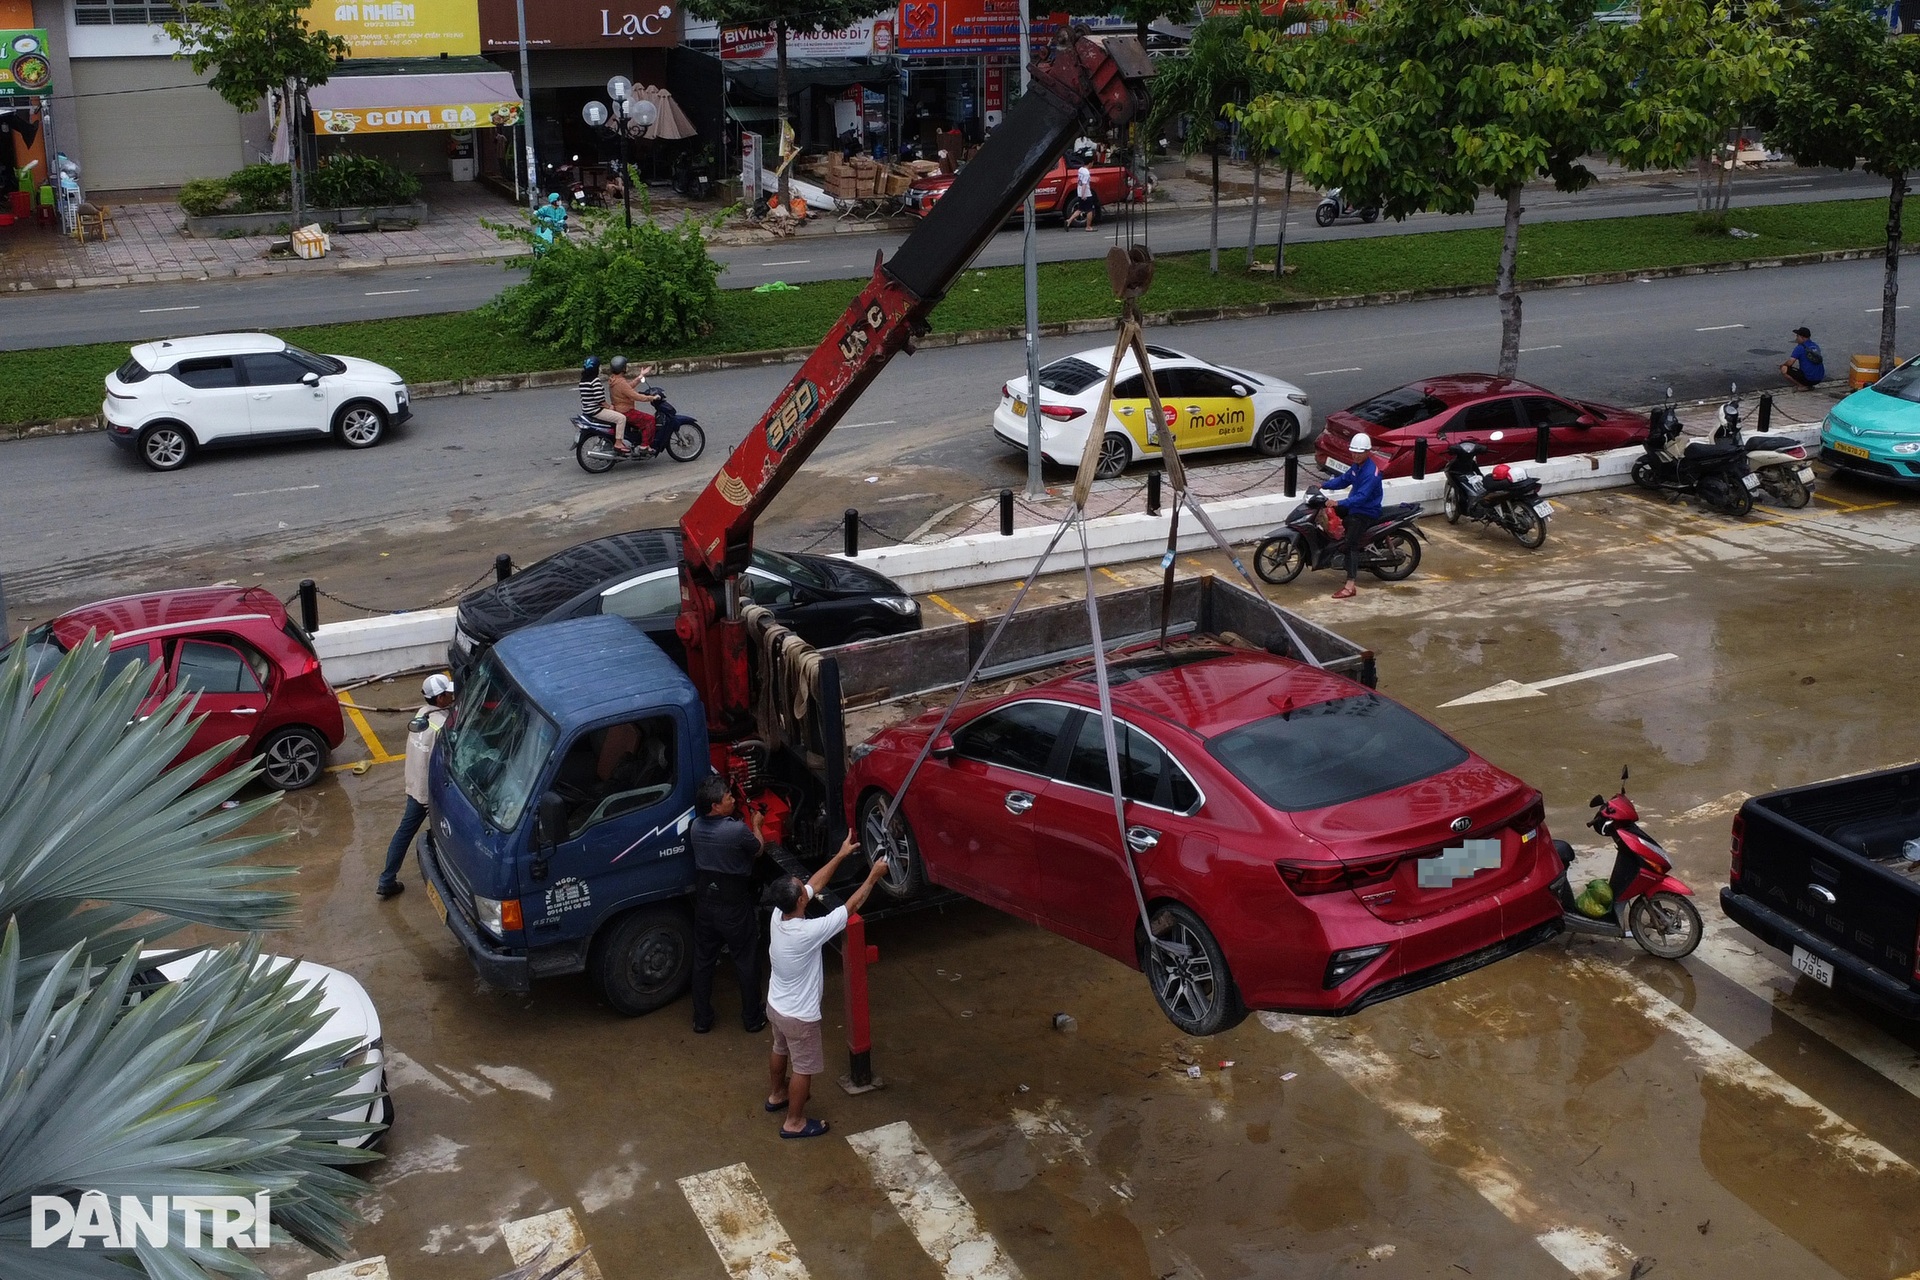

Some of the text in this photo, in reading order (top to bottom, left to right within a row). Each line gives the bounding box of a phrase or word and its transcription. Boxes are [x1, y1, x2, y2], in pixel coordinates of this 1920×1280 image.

[335, 1, 415, 21] AN NHIÊN
[600, 9, 662, 41] Lạc
[863, 29, 870, 39] 7
[366, 105, 476, 126] CƠM GÀ
[769, 384, 813, 447] 360
[1189, 408, 1245, 429] maxim
[1454, 818, 1471, 832] KIA
[659, 845, 686, 858] HD99
[1805, 951, 1822, 968] 79C
[1798, 958, 1828, 984] 179.85
